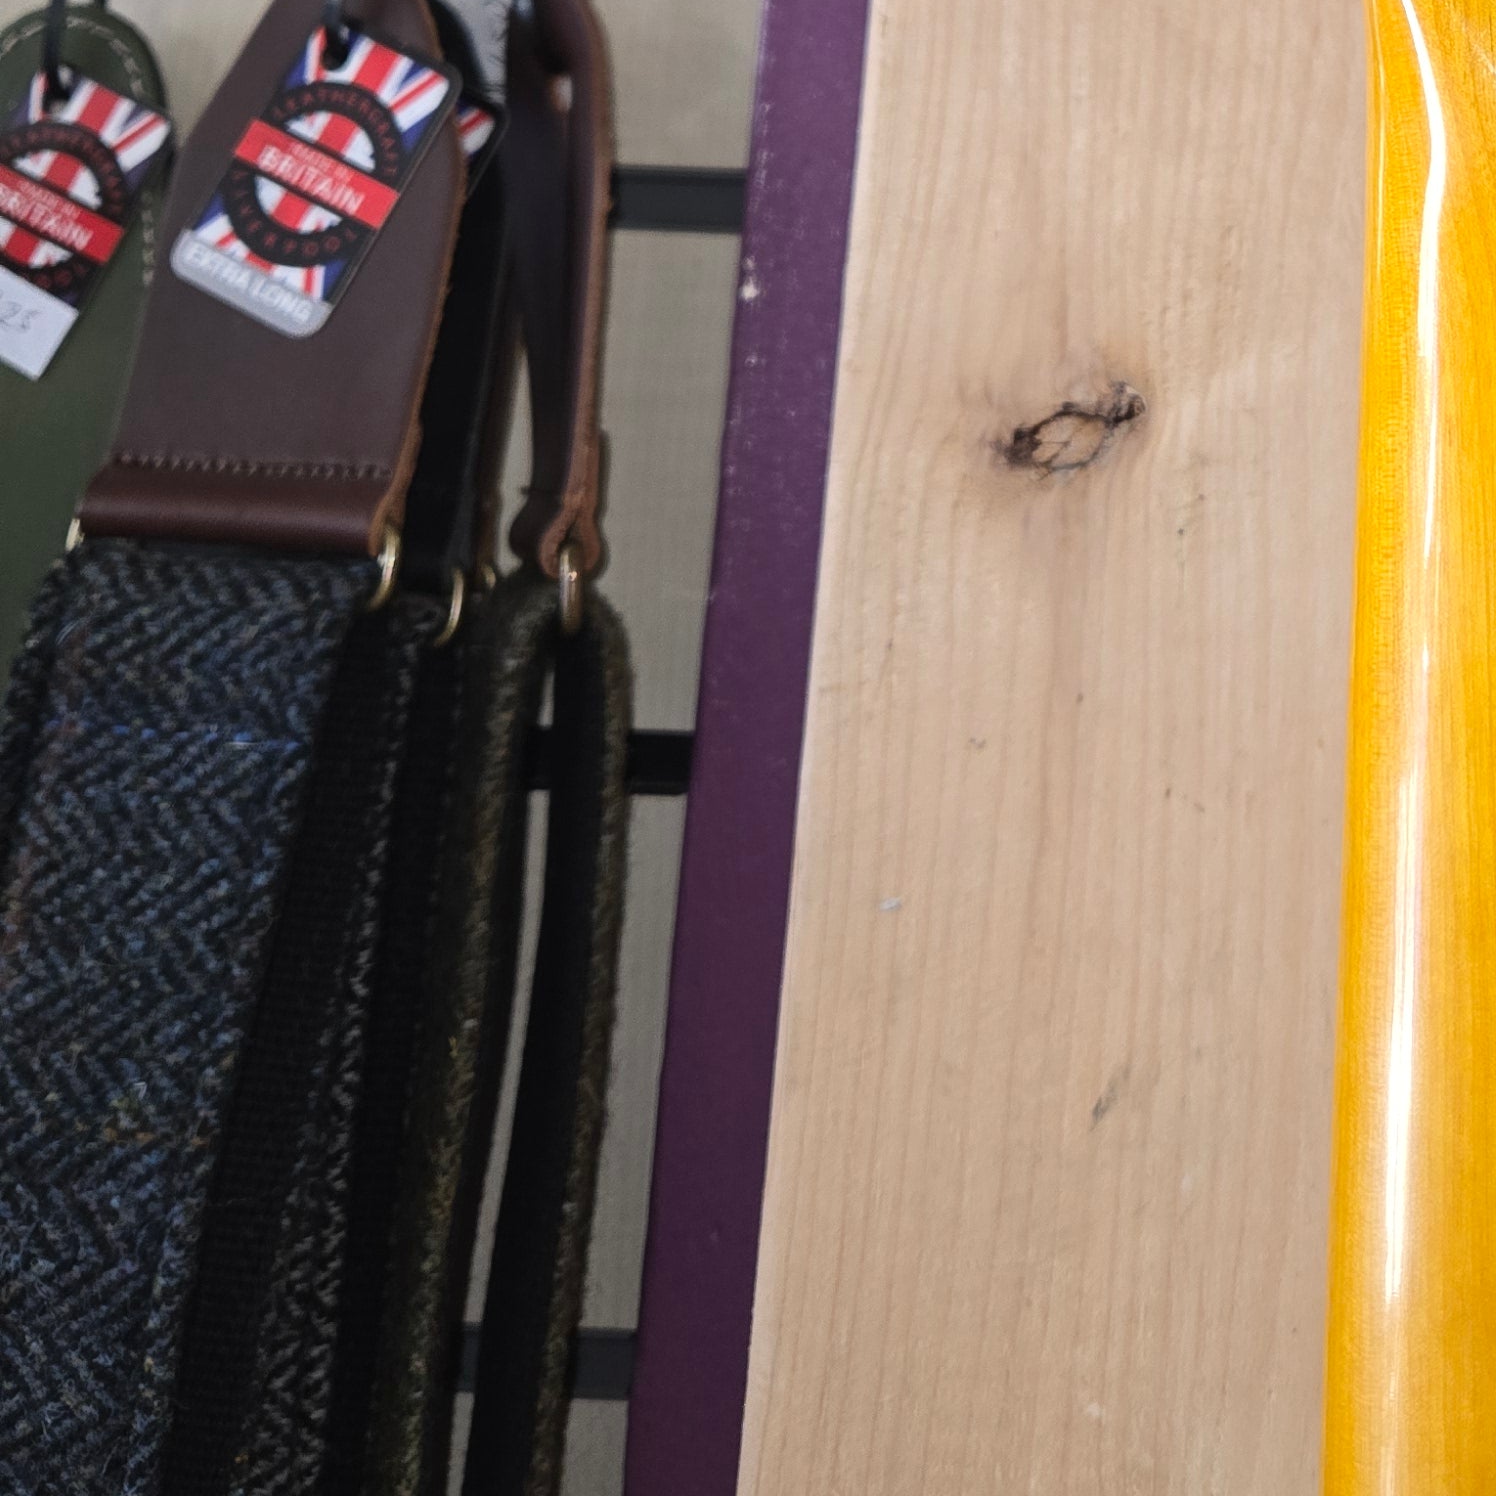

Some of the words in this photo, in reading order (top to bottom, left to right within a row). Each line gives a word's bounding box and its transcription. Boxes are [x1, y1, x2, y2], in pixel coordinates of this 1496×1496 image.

[256, 143, 366, 215] BRITAIN
[185, 242, 254, 290] EXTRA
[252, 278, 315, 322] LONG
